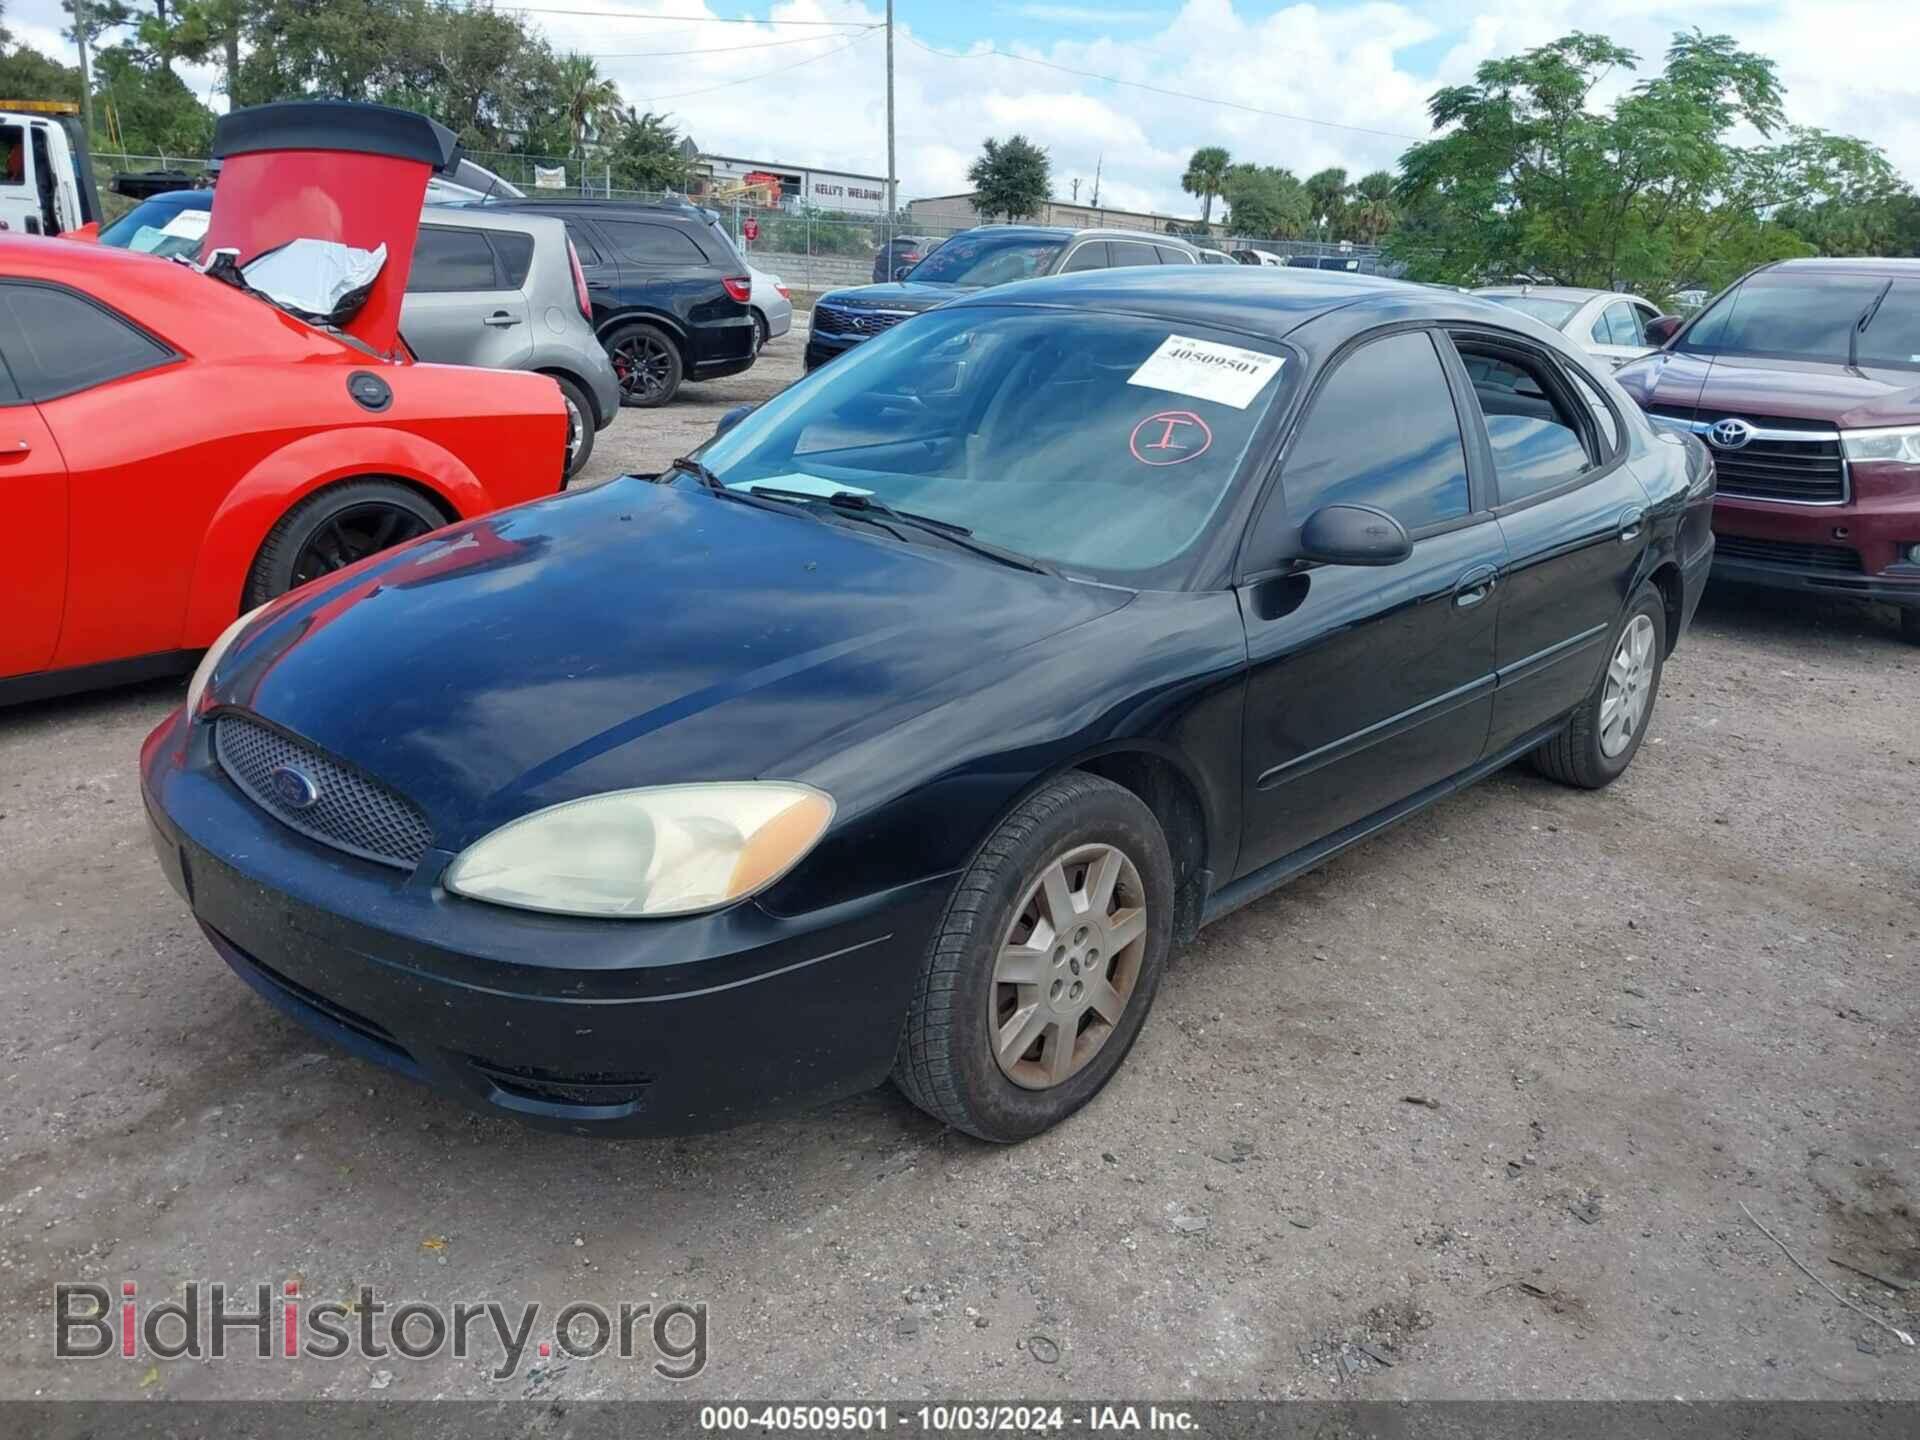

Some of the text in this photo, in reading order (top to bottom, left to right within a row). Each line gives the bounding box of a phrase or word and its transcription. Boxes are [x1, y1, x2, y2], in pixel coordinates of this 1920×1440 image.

[815, 183, 882, 200] KELLY'S WELDING
[1168, 348, 1260, 375] 40509501
